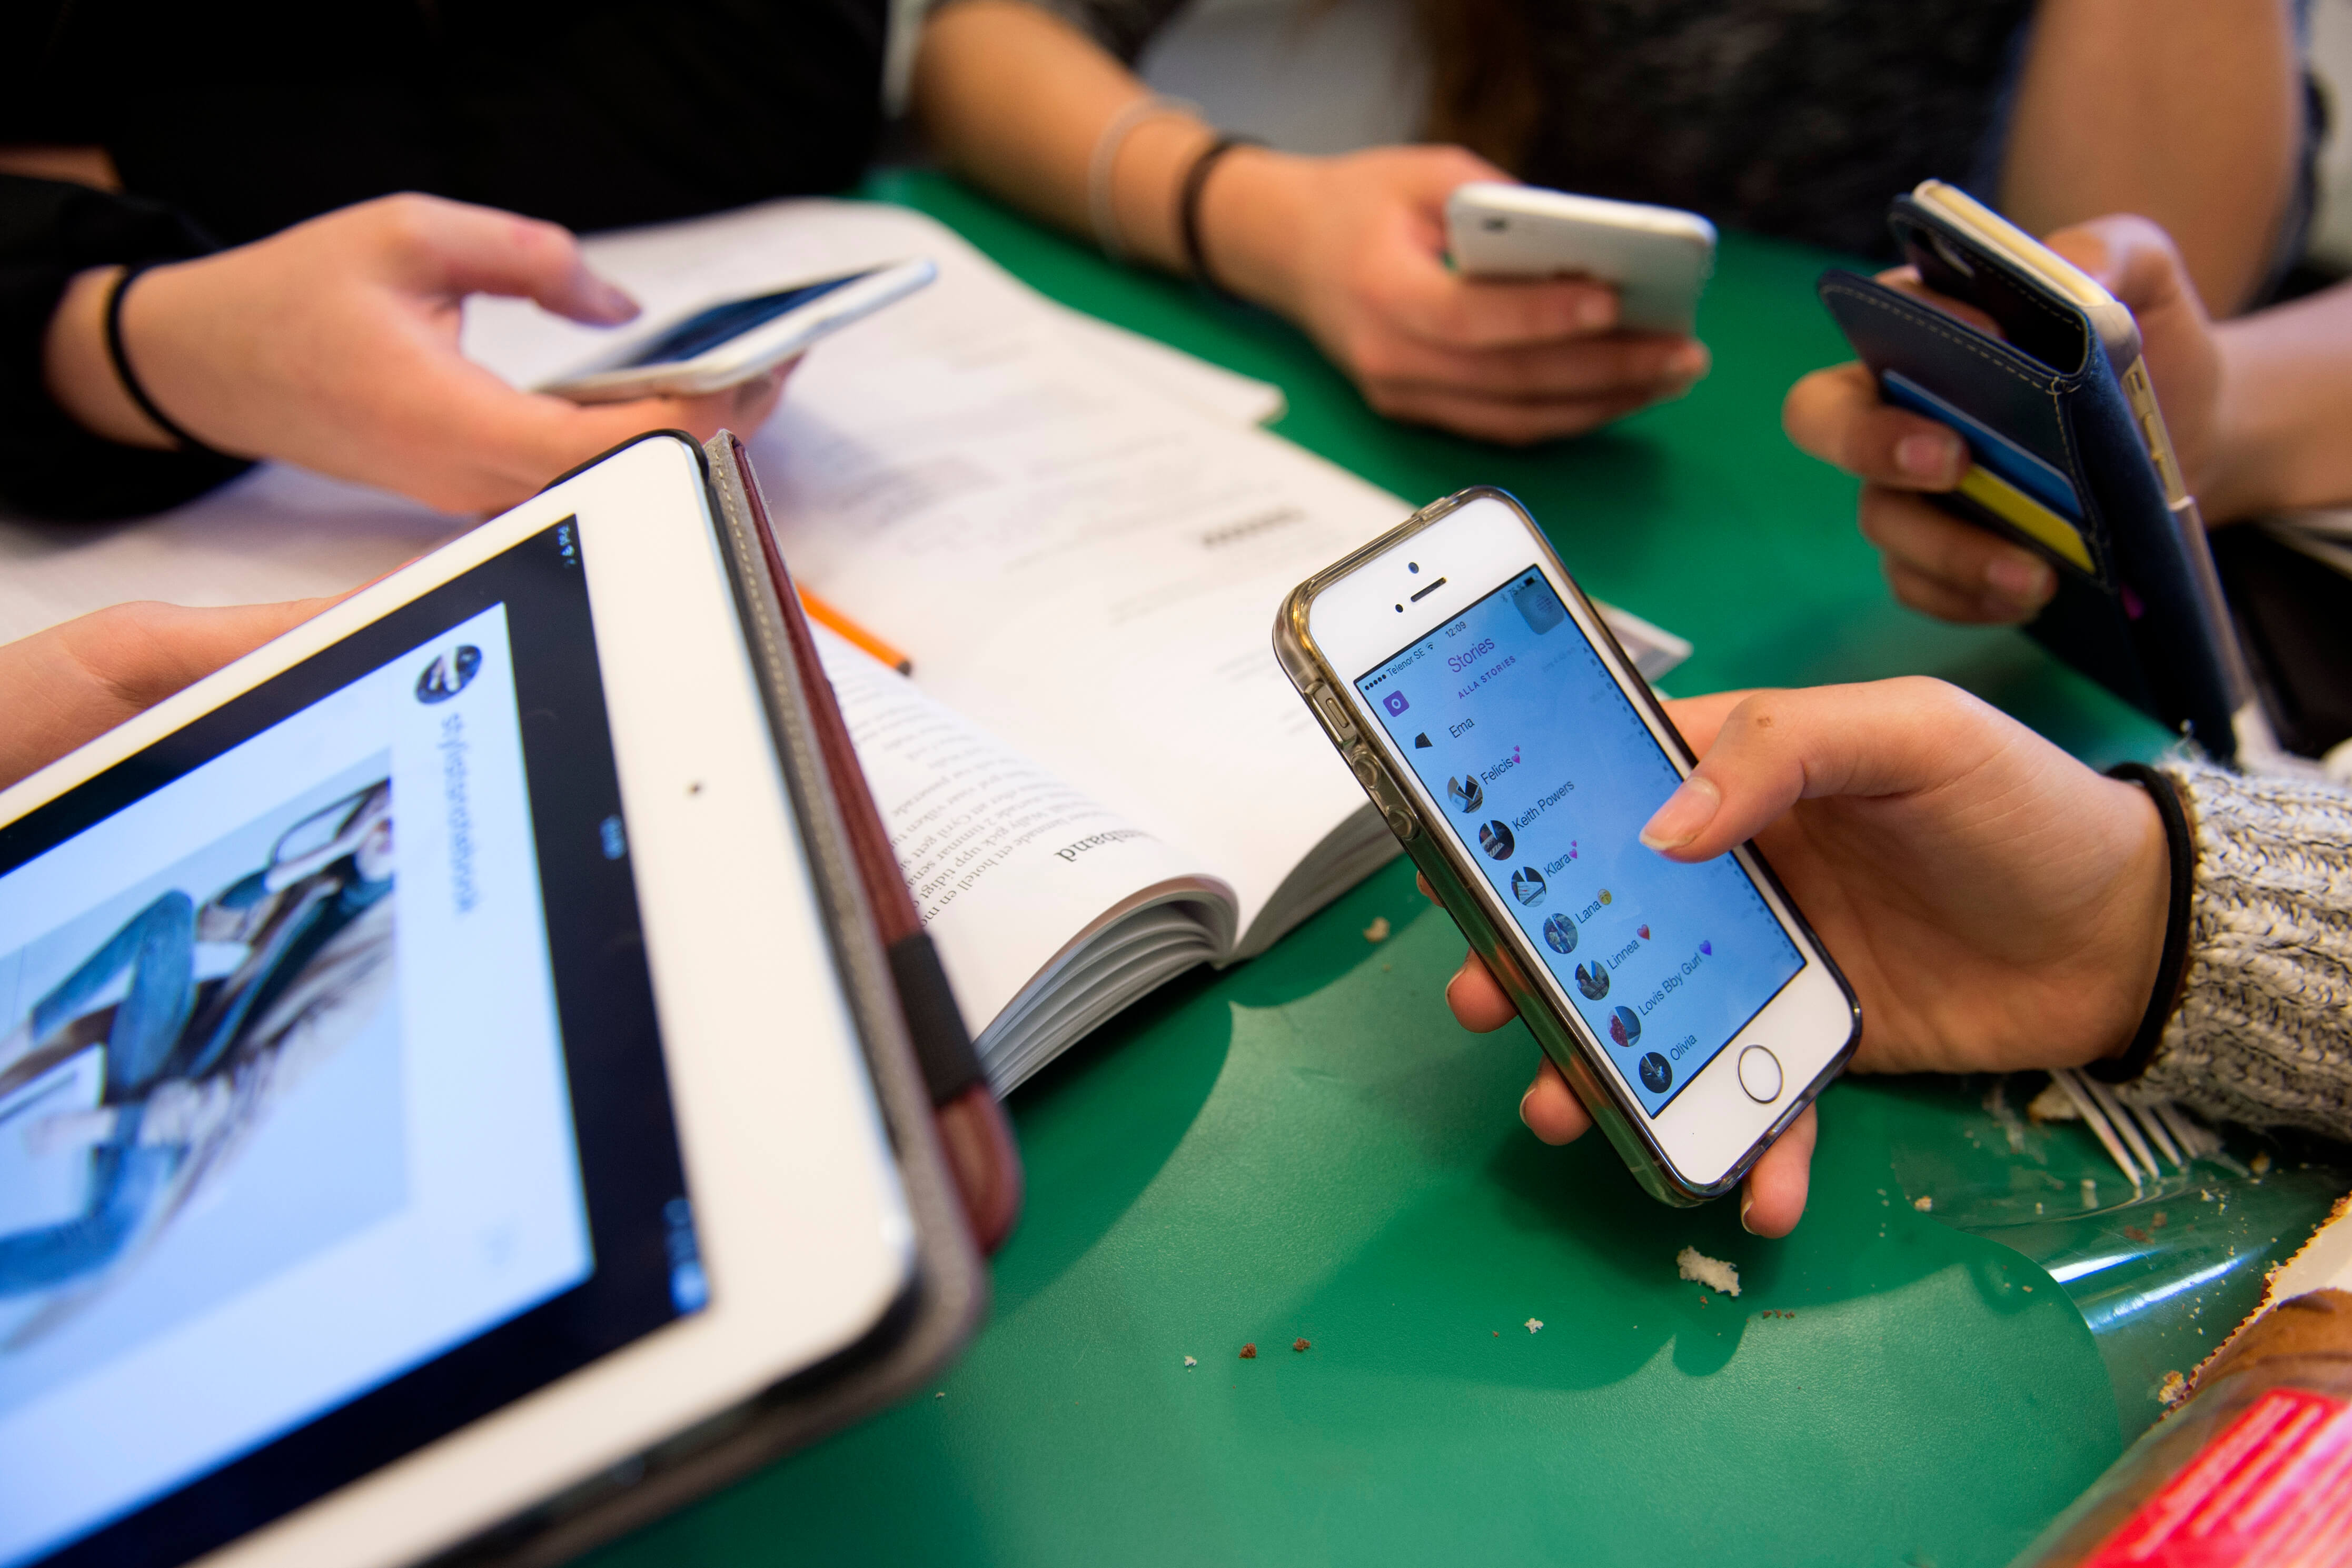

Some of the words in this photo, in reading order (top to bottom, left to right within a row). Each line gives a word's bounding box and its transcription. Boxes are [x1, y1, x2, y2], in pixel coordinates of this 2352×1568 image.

[1445, 621, 1467, 638] 12:09
[1386, 656, 1414, 677] Telenor
[1414, 648, 1426, 660] SE
[1447, 638, 1495, 673] Stories
[1458, 681, 1480, 699] ALLA
[1480, 656, 1516, 683] STORIES
[1449, 718, 1475, 739] Ema
[1480, 757, 1514, 785] Felicis
[1512, 807, 1540, 832] Keith
[1537, 779, 1575, 812] Powers
[937, 823, 985, 861] timmar
[994, 845, 1013, 858] ett
[955, 847, 983, 867] upp
[1544, 854, 1572, 878] Klara
[919, 868, 956, 899] tidigt
[957, 858, 999, 891] hotell
[939, 890, 957, 905] en
[1575, 899, 1602, 925] Lana
[1606, 939, 1641, 970] Linnea
[1638, 988, 1665, 1017] Lovis
[1662, 971, 1684, 994] Bby
[1681, 952, 1703, 976] Gurl
[1670, 1033, 1699, 1062] Olivia
